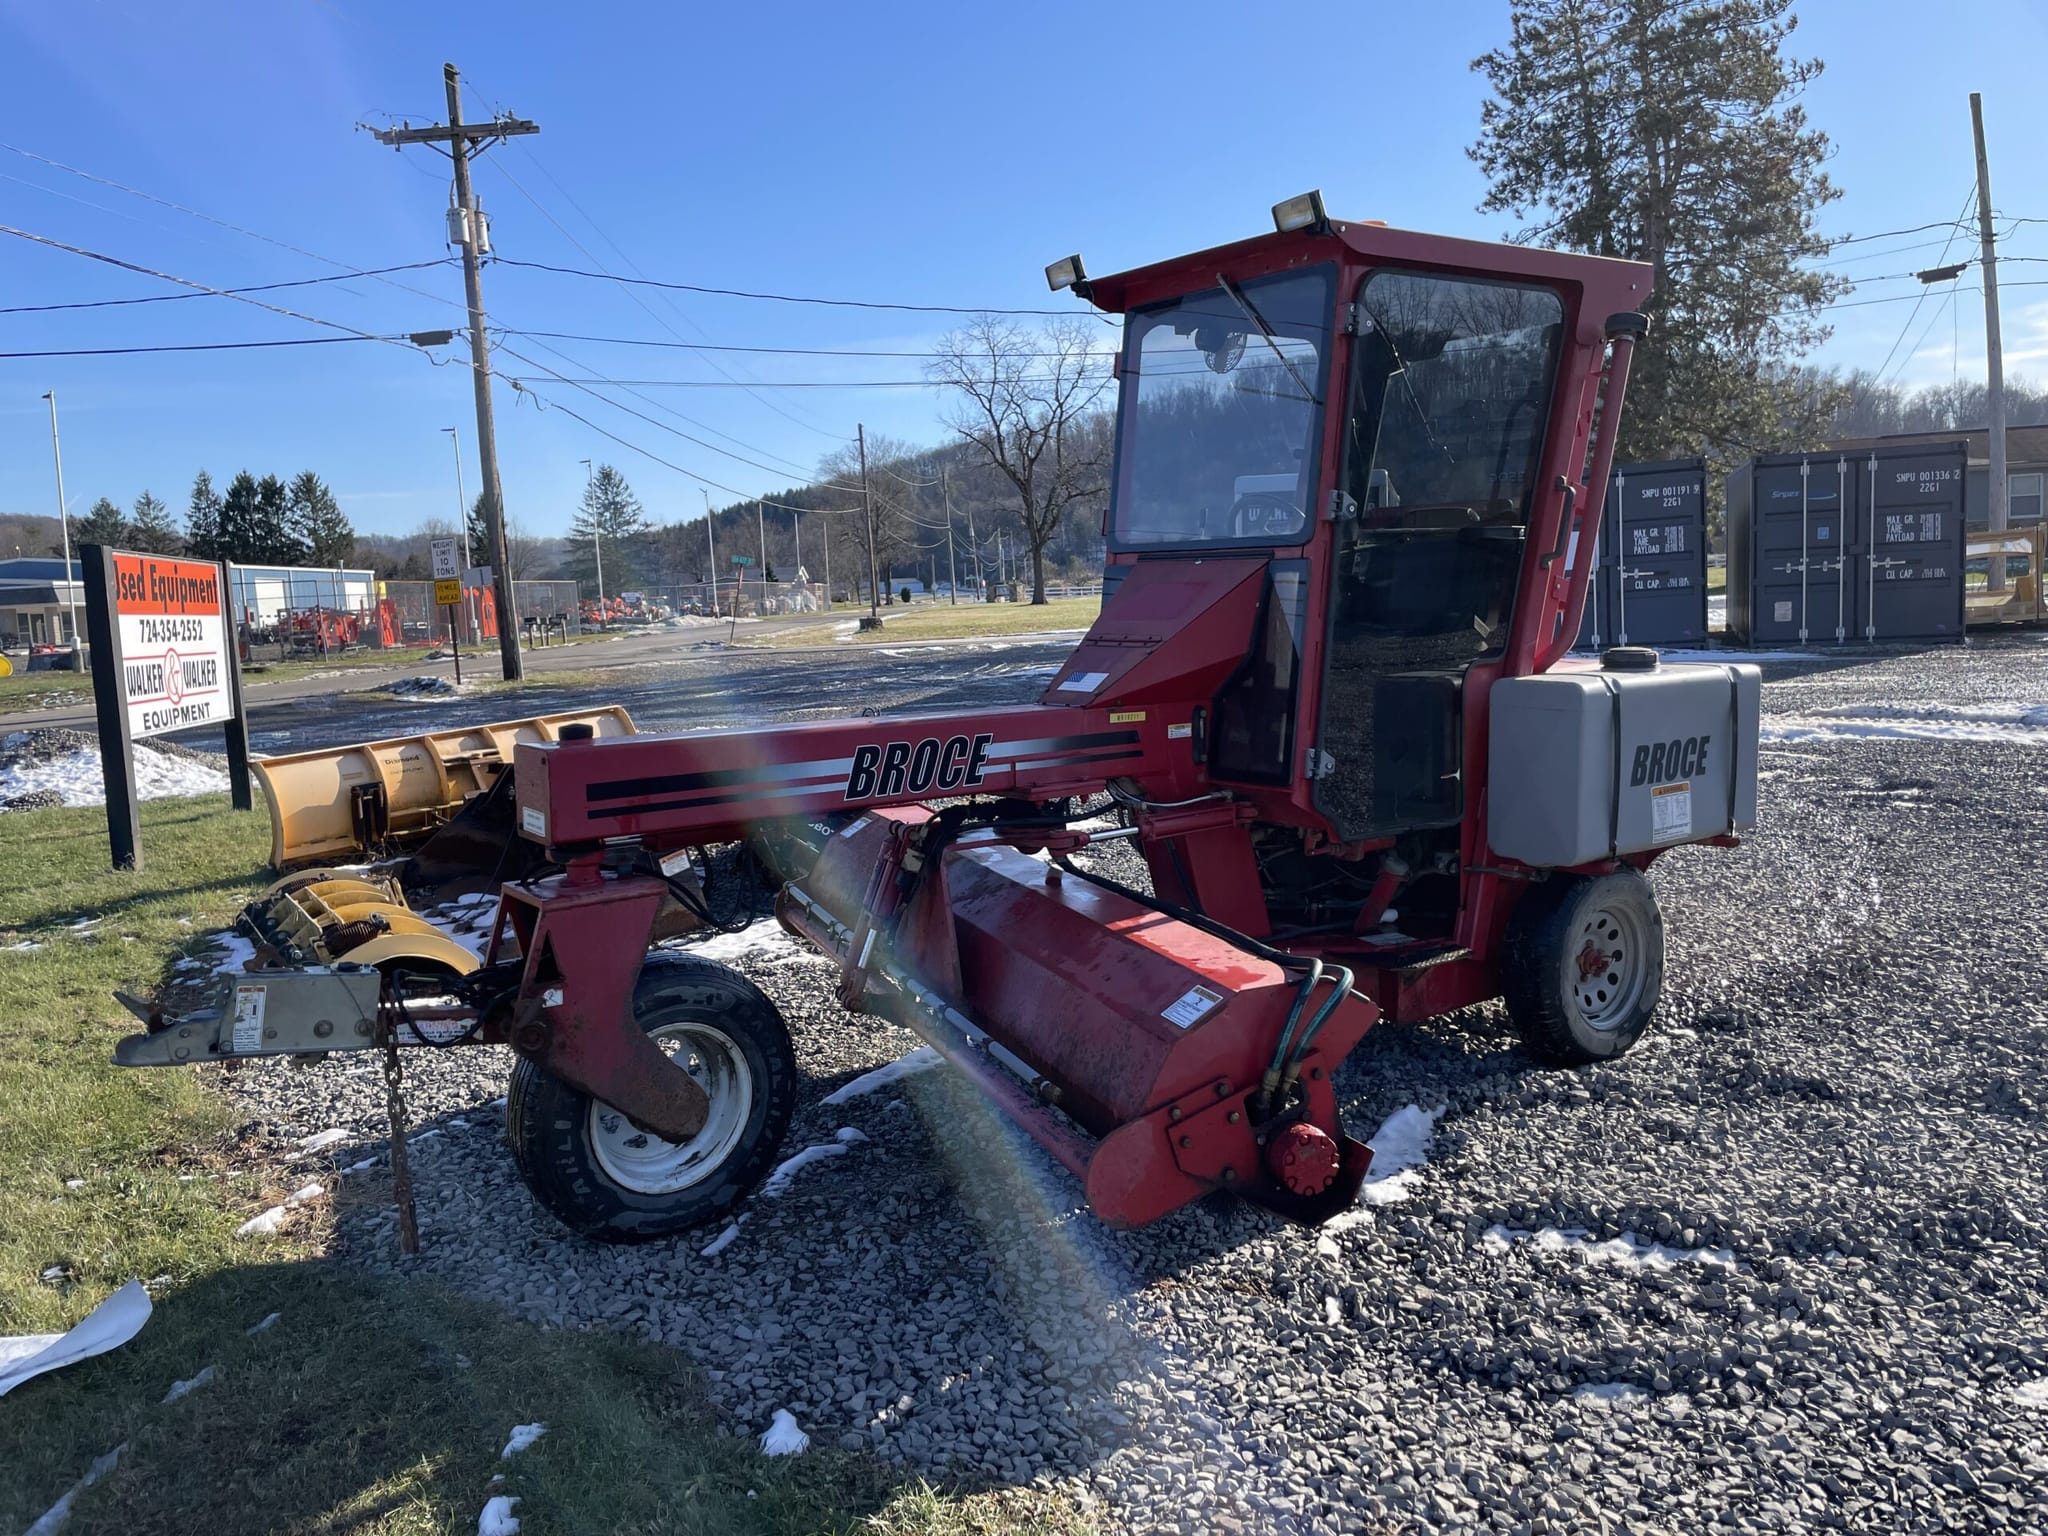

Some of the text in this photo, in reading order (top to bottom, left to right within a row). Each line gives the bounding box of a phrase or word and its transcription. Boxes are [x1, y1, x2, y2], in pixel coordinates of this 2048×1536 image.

[1896, 469, 1960, 482] SNPU 001336 2
[1641, 488, 1660, 498] SNPU
[1662, 485, 1690, 496] 001191
[1920, 483, 1939, 492] 22G1
[1663, 498, 1681, 507] 22G1
[1886, 523, 1903, 533] TARE
[1634, 537, 1649, 546] TARE
[1886, 532, 1915, 543] PAYLOAD
[432, 541, 453, 549] WEIGHT
[1633, 544, 1660, 555] PAYLOAD
[440, 558, 448, 566] 10
[436, 567, 455, 576] TONS
[1900, 569, 1914, 579] CAP.
[150, 564, 218, 613] Equipment
[1647, 579, 1661, 589] CAP.
[139, 619, 203, 643] 724-354-2552
[126, 664, 164, 697] WALKER
[183, 659, 217, 689] WALKER
[143, 702, 210, 730] EQUIPMENT
[1630, 735, 1711, 787] BROCE
[844, 733, 993, 801] BROCE
